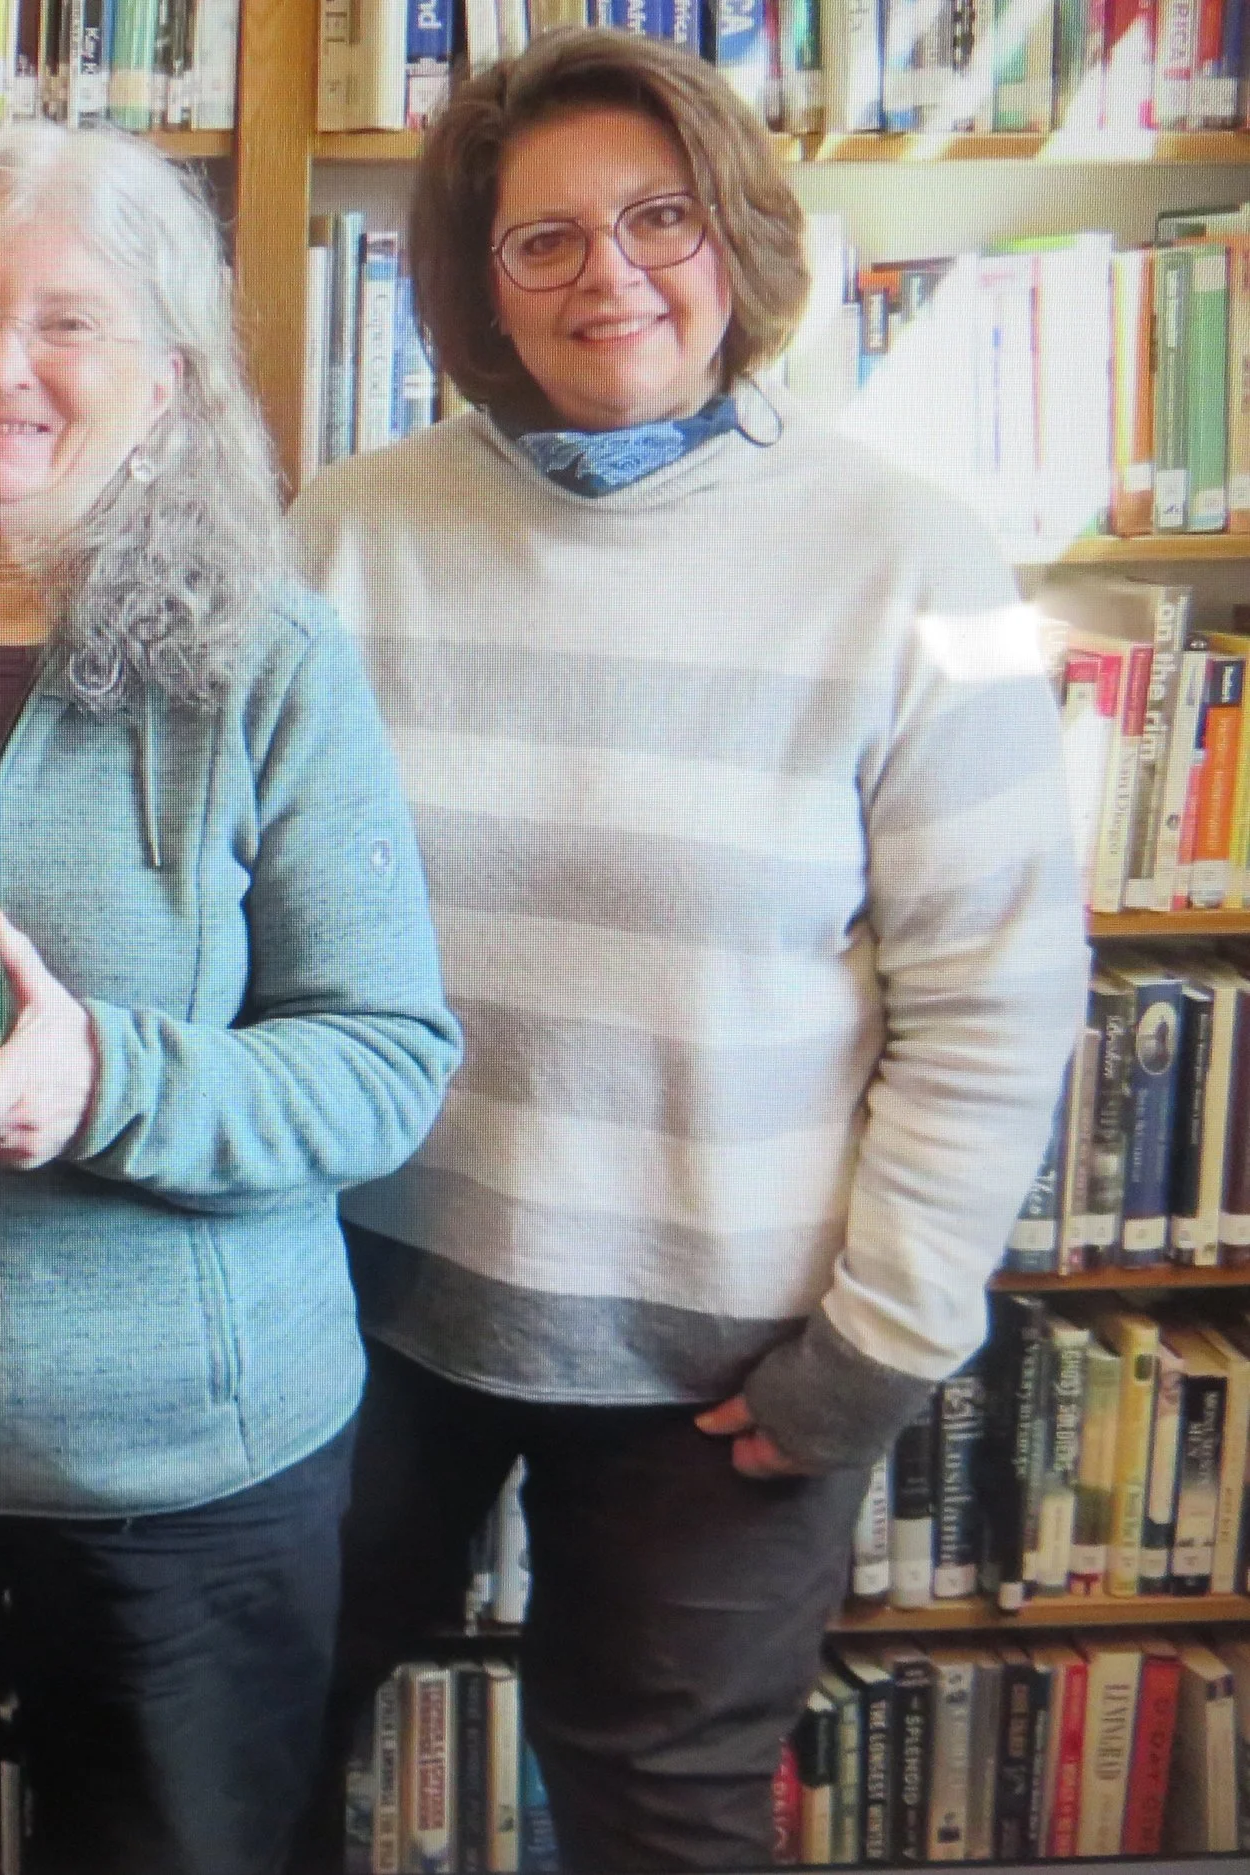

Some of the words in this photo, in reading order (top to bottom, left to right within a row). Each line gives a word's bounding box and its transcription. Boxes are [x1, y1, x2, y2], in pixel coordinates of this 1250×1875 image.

[1155, 602, 1177, 643] on
[1148, 651, 1177, 704] the
[1139, 710, 1168, 762] rim
[869, 1700, 888, 1729] THE
[1093, 1683, 1132, 1781] LENINGRAD
[901, 1714, 925, 1805] SPLENDID
